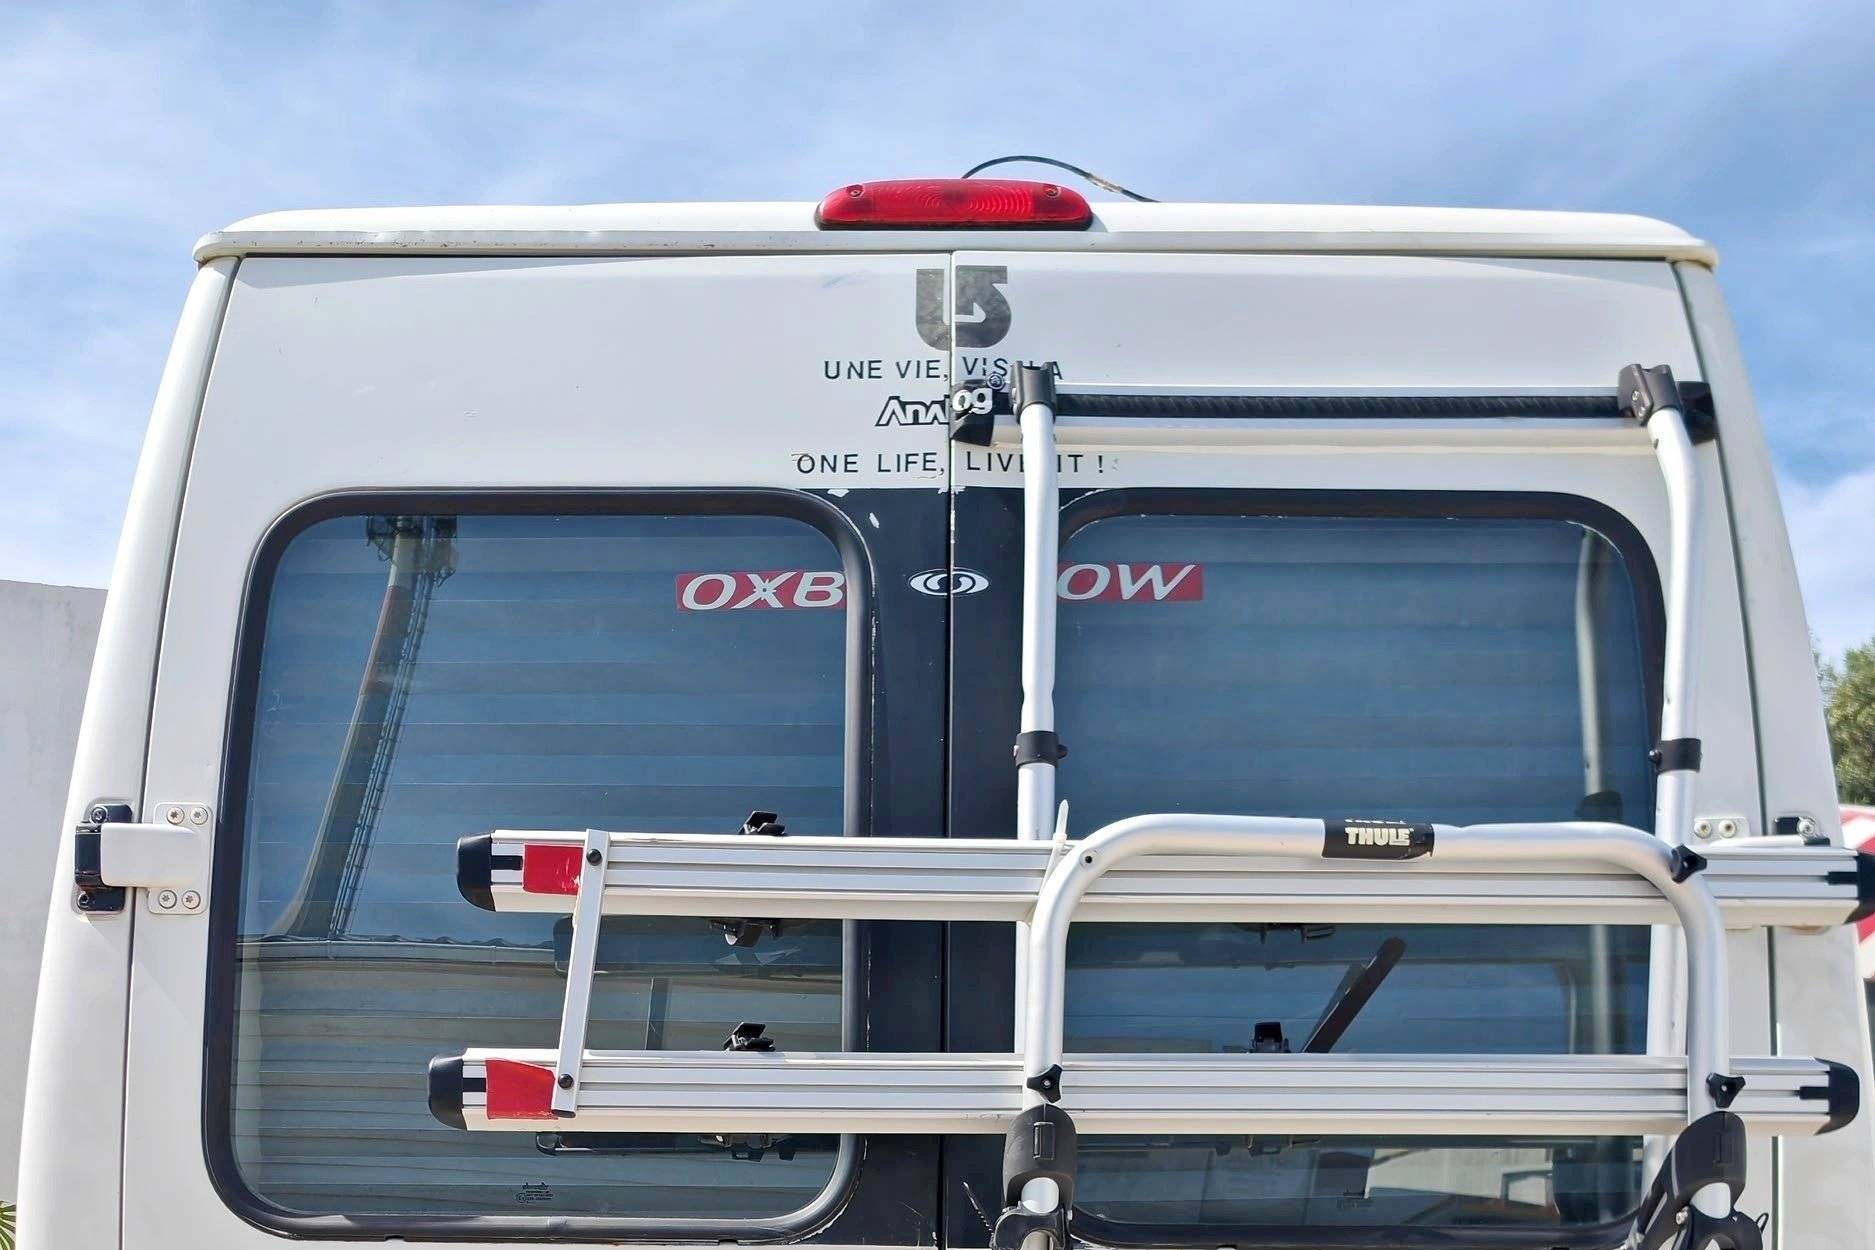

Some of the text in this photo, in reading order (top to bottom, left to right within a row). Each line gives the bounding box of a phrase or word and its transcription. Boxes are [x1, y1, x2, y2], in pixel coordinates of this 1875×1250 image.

[824, 360, 883, 380] UNE
[896, 359, 950, 382] VIE,
[796, 453, 859, 474] ONE
[877, 452, 945, 476] LIFE,
[966, 451, 1024, 473] LIV
[1056, 454, 1084, 473] IT
[680, 571, 847, 611] OXB
[1345, 827, 1411, 846] THULE
